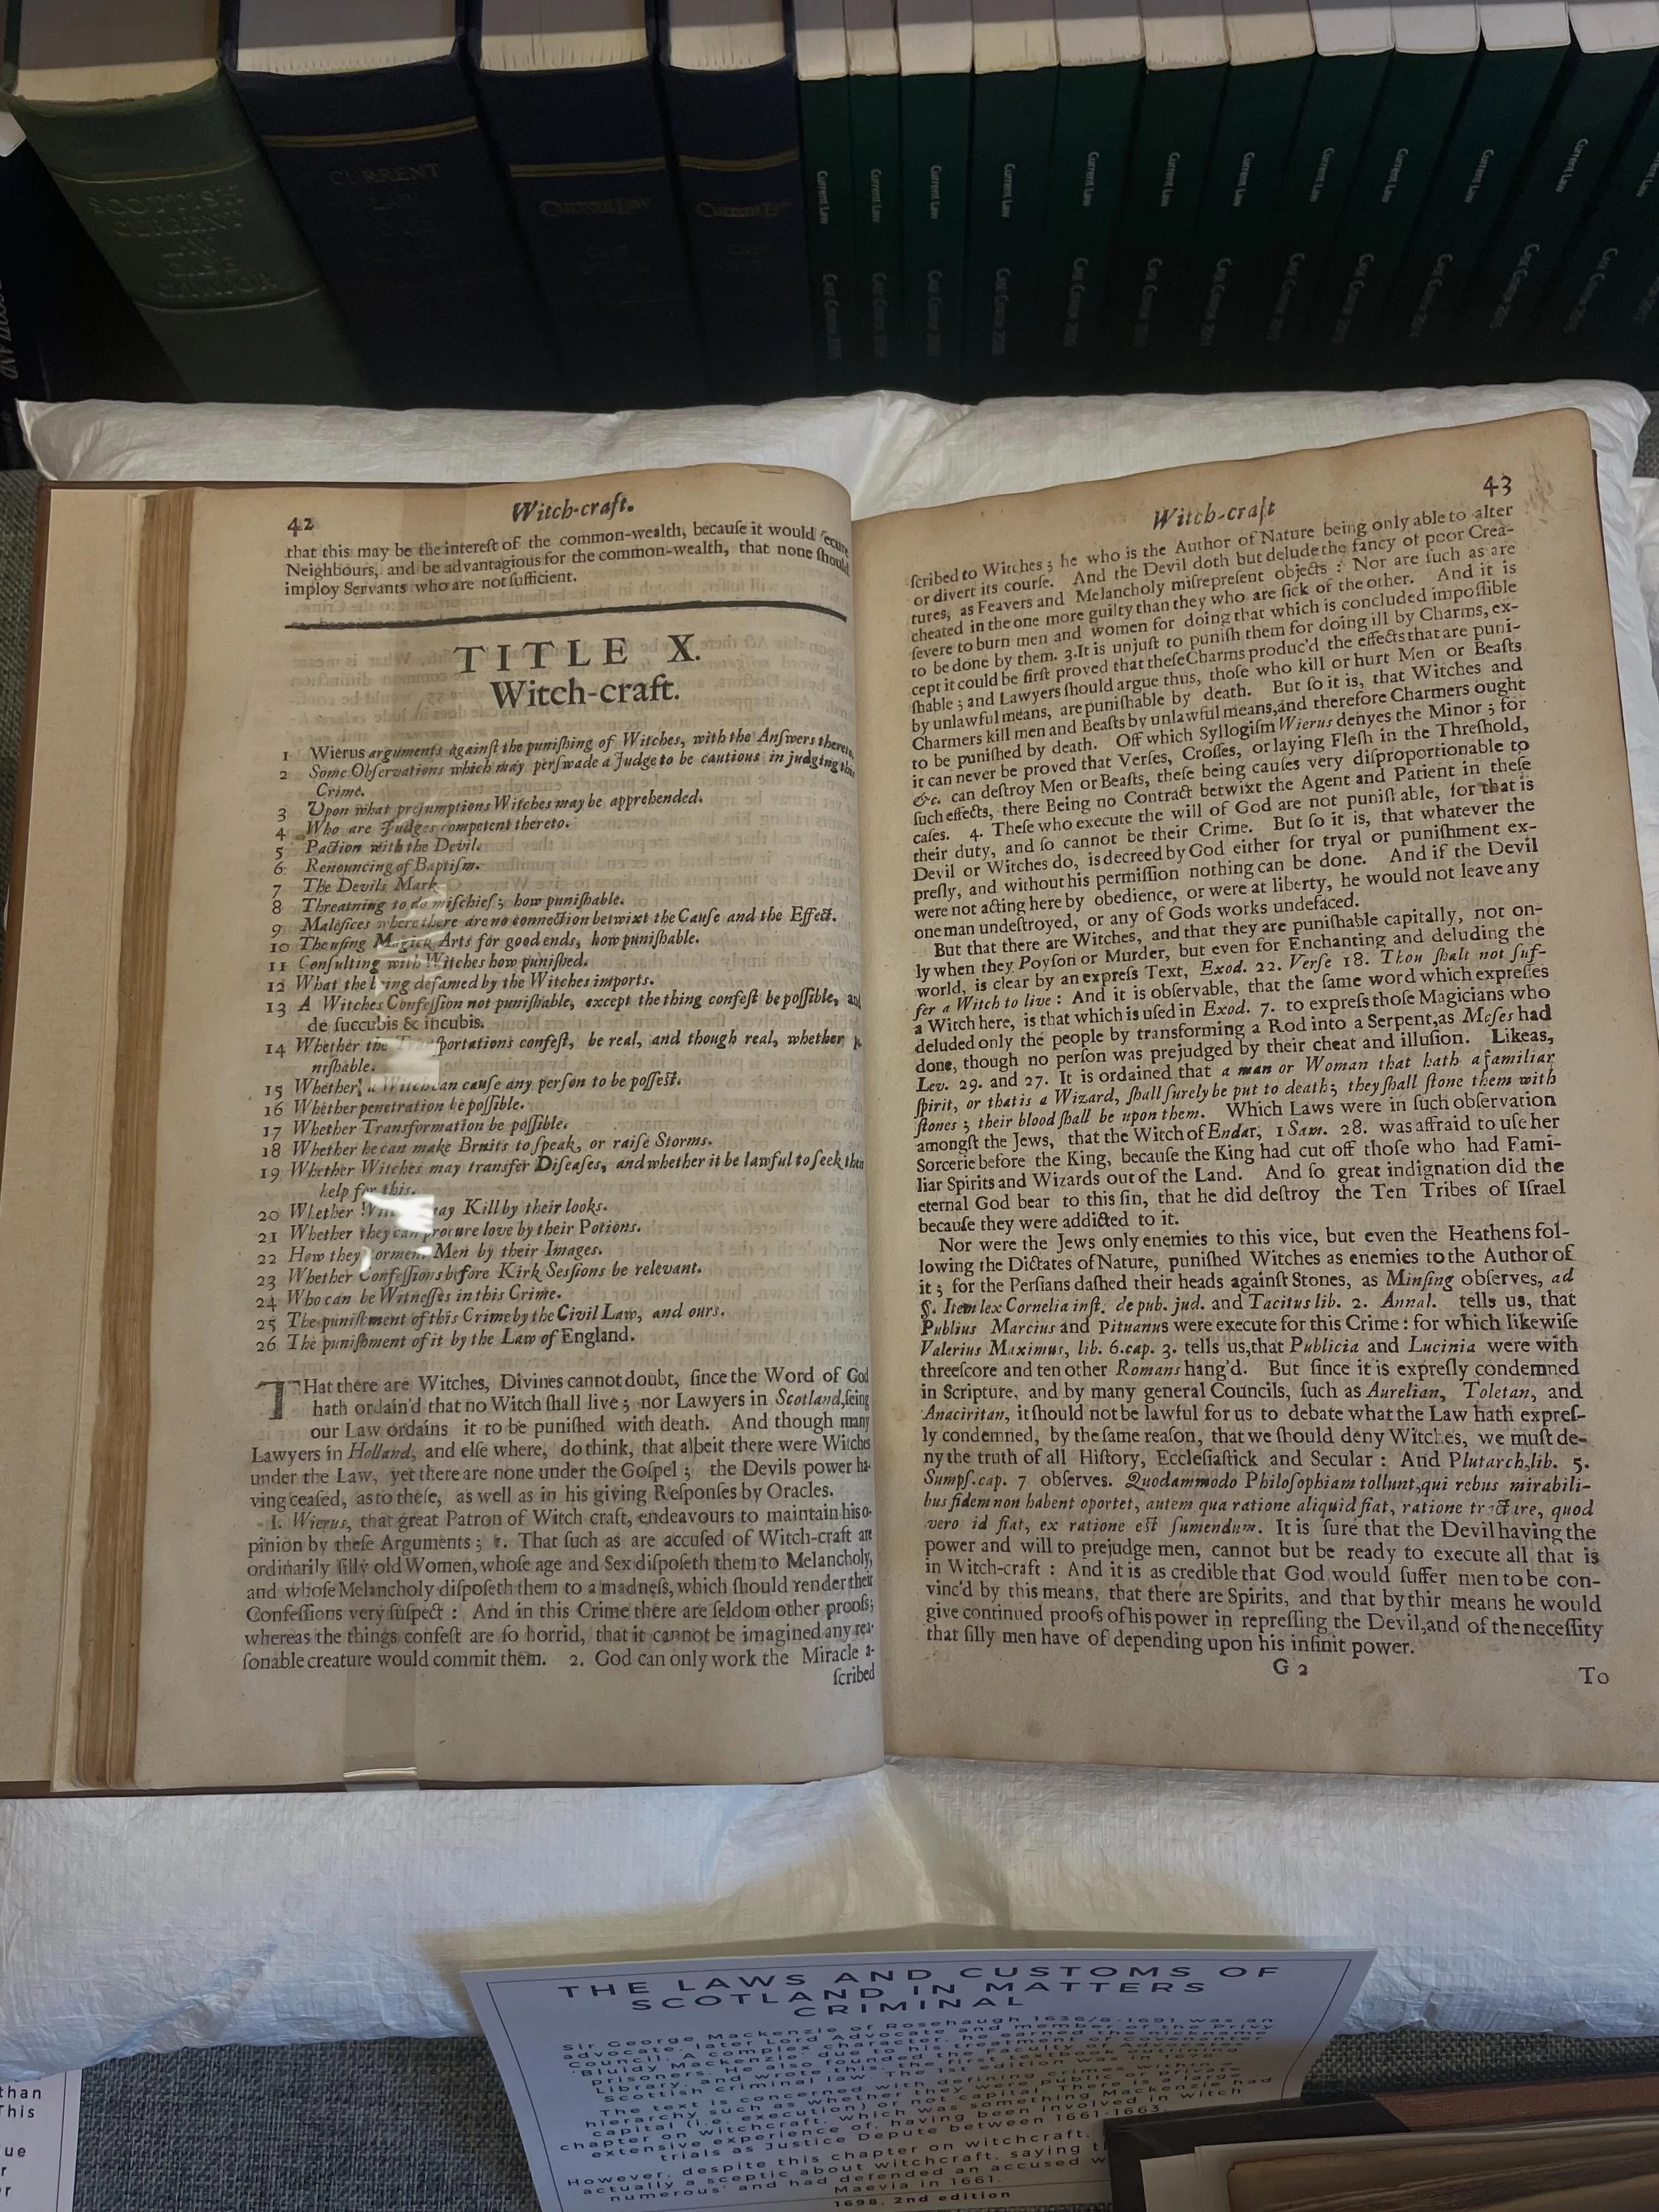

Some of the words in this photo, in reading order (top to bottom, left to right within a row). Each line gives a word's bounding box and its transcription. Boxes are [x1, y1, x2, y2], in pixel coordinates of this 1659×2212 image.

[1316, 147, 1334, 182] Current
[1388, 148, 1408, 183] Current
[1472, 149, 1494, 183] Current
[1563, 139, 1588, 173] Current
[330, 163, 439, 186] CURRENT
[1003, 163, 1015, 198] Current
[1086, 152, 1099, 186] Current
[1164, 152, 1180, 187] Current
[1238, 152, 1255, 186] Current
[818, 171, 828, 205] Current
[871, 169, 882, 203] Current
[930, 165, 942, 200] Current
[1483, 476, 1511, 497] 43
[287, 518, 314, 537] 42
[1324, 521, 1366, 537] being
[287, 545, 317, 558] that
[323, 544, 350, 557] this
[358, 548, 390, 561] may
[529, 535, 550, 548] the
[560, 522, 686, 546] common-wealth,
[287, 562, 378, 581] Neighbours,
[388, 561, 415, 575] and
[599, 540, 729, 561] common-wealth,
[740, 540, 769, 553] that
[778, 546, 812, 559] none
[1143, 558, 1189, 578] Devil
[285, 582, 340, 599] imploy
[344, 582, 407, 595] Servants
[1342, 588, 1426, 611] concluded
[453, 637, 627, 673] TITLE
[668, 634, 700, 662] X.
[1398, 647, 1434, 662] Men
[1411, 661, 1480, 680] Witches
[490, 674, 679, 709] Witch-craft.
[1391, 685, 1469, 701] Charmers
[311, 746, 365, 759] Wierus
[701, 752, 760, 764] cautious
[317, 782, 364, 797] Crime.
[610, 788, 703, 811] apprehended.
[1046, 796, 1090, 814] Being
[987, 857, 1047, 873] Witches
[934, 943, 961, 957] But
[1072, 930, 1141, 946] Witches,
[1288, 934, 1386, 950] Enchanting
[1432, 925, 1508, 944] deluding
[1368, 968, 1416, 986] word
[1290, 1101, 1333, 1116] Laws
[362, 1159, 423, 1175] Witches
[1033, 1170, 1100, 1187] Wizards
[1388, 1158, 1490, 1181] indignation
[1420, 1181, 1476, 1197] Tribes
[918, 1196, 968, 1212] eternal
[418, 1374, 489, 1393] Witches,
[500, 1373, 563, 1389] Divines
[764, 1366, 814, 1383] Word
[492, 1395, 541, 1412] Witch
[1144, 1382, 1206, 1404] general
[311, 1428, 338, 1438] our
[346, 1423, 381, 1438] Law
[387, 1420, 447, 1437] ordains
[732, 1412, 768, 1430] And
[252, 1447, 321, 1467] Lawyers
[767, 1481, 833, 1499] Oracles.
[1082, 1538, 1151, 1560] prejudge
[1434, 1550, 1500, 1562] execute
[1172, 1562, 1237, 1580] credible
[1114, 1629, 1202, 1655] depending
[1352, 1637, 1413, 1659] power.
[308, 1654, 372, 1668] creature
[433, 1649, 496, 1667] commit
[501, 1649, 545, 1666] them.
[802, 1644, 858, 1664] Miracle
[1273, 1658, 1289, 1674] G
[1299, 1664, 1307, 1676] 2
[1579, 1666, 1609, 1684] To
[558, 1982, 649, 1998] THE
[678, 1975, 805, 1990] LAWS
[834, 1970, 931, 1983] AND
[960, 1967, 1190, 1978] CUSTOMS
[1220, 1967, 1278, 1977] OF
[632, 1988, 883, 2011] SCOTLAND
[914, 1984, 954, 1995] IN
[986, 1982, 1204, 1992] MATTERS
[794, 1996, 1023, 2016] CRIMINAL
[608, 2036, 694, 2047] George
[708, 2028, 837, 2040] Mackenzie
[887, 2017, 1019, 2029] Rosehaugh
[832, 2028, 944, 2040] Advocate
[826, 2054, 922, 2065] founded
[605, 2089, 702, 2102] Scottish
[716, 2078, 814, 2092] criminal
[654, 2102, 698, 2110] text
[740, 2086, 861, 2103] concerned
[876, 2081, 924, 2090] with
[586, 2112, 696, 2128] hierarchy
[709, 2105, 760, 2116] such
[560, 2136, 649, 2151] chapter
[839, 2110, 904, 2121] which
[592, 2141, 701, 2158] extensive
[713, 2126, 839, 2145] experience
[891, 2114, 964, 2126] having
[661, 2149, 720, 2161] trials
[765, 2136, 845, 2150] Justice
[859, 2127, 937, 2141] Depute
[950, 2116, 1043, 2132] between
[583, 2181, 673, 2194] actually
[707, 2170, 788, 2184] sceptic
[800, 2164, 863, 2175] about
[1011, 2143, 1080, 2158] saying
[683, 2161, 766, 2175] despite
[778, 2156, 820, 2166] this
[831, 2146, 918, 2161] chapter
[790, 2177, 828, 2186] had
[840, 2168, 943, 2183] defended
[991, 2158, 1079, 2172] accused
[835, 2181, 908, 2194] Maevia
[938, 2191, 1010, 2201] edition
